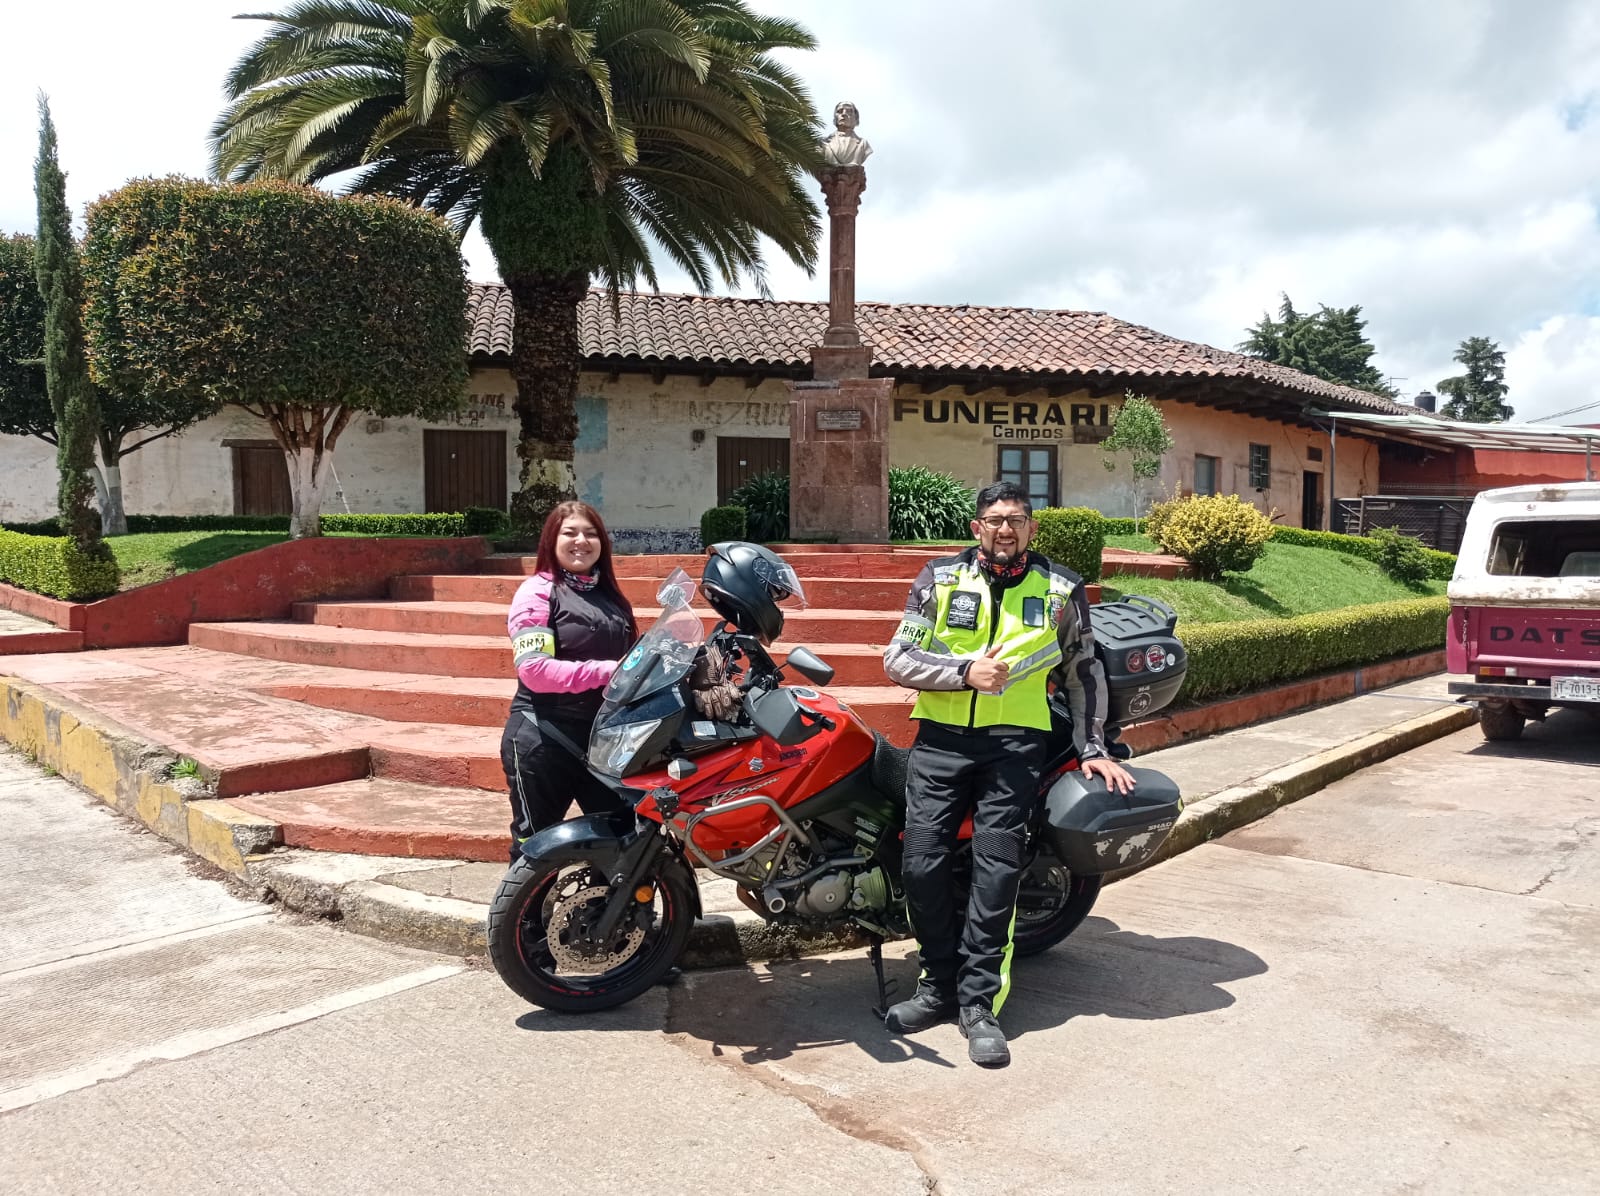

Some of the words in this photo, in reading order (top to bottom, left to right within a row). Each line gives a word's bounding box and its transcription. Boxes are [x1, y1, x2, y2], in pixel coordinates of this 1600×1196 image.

[893, 399, 1123, 427] FUNERARI
[992, 424, 1064, 440] Campos
[1490, 626, 1600, 646] DATS
